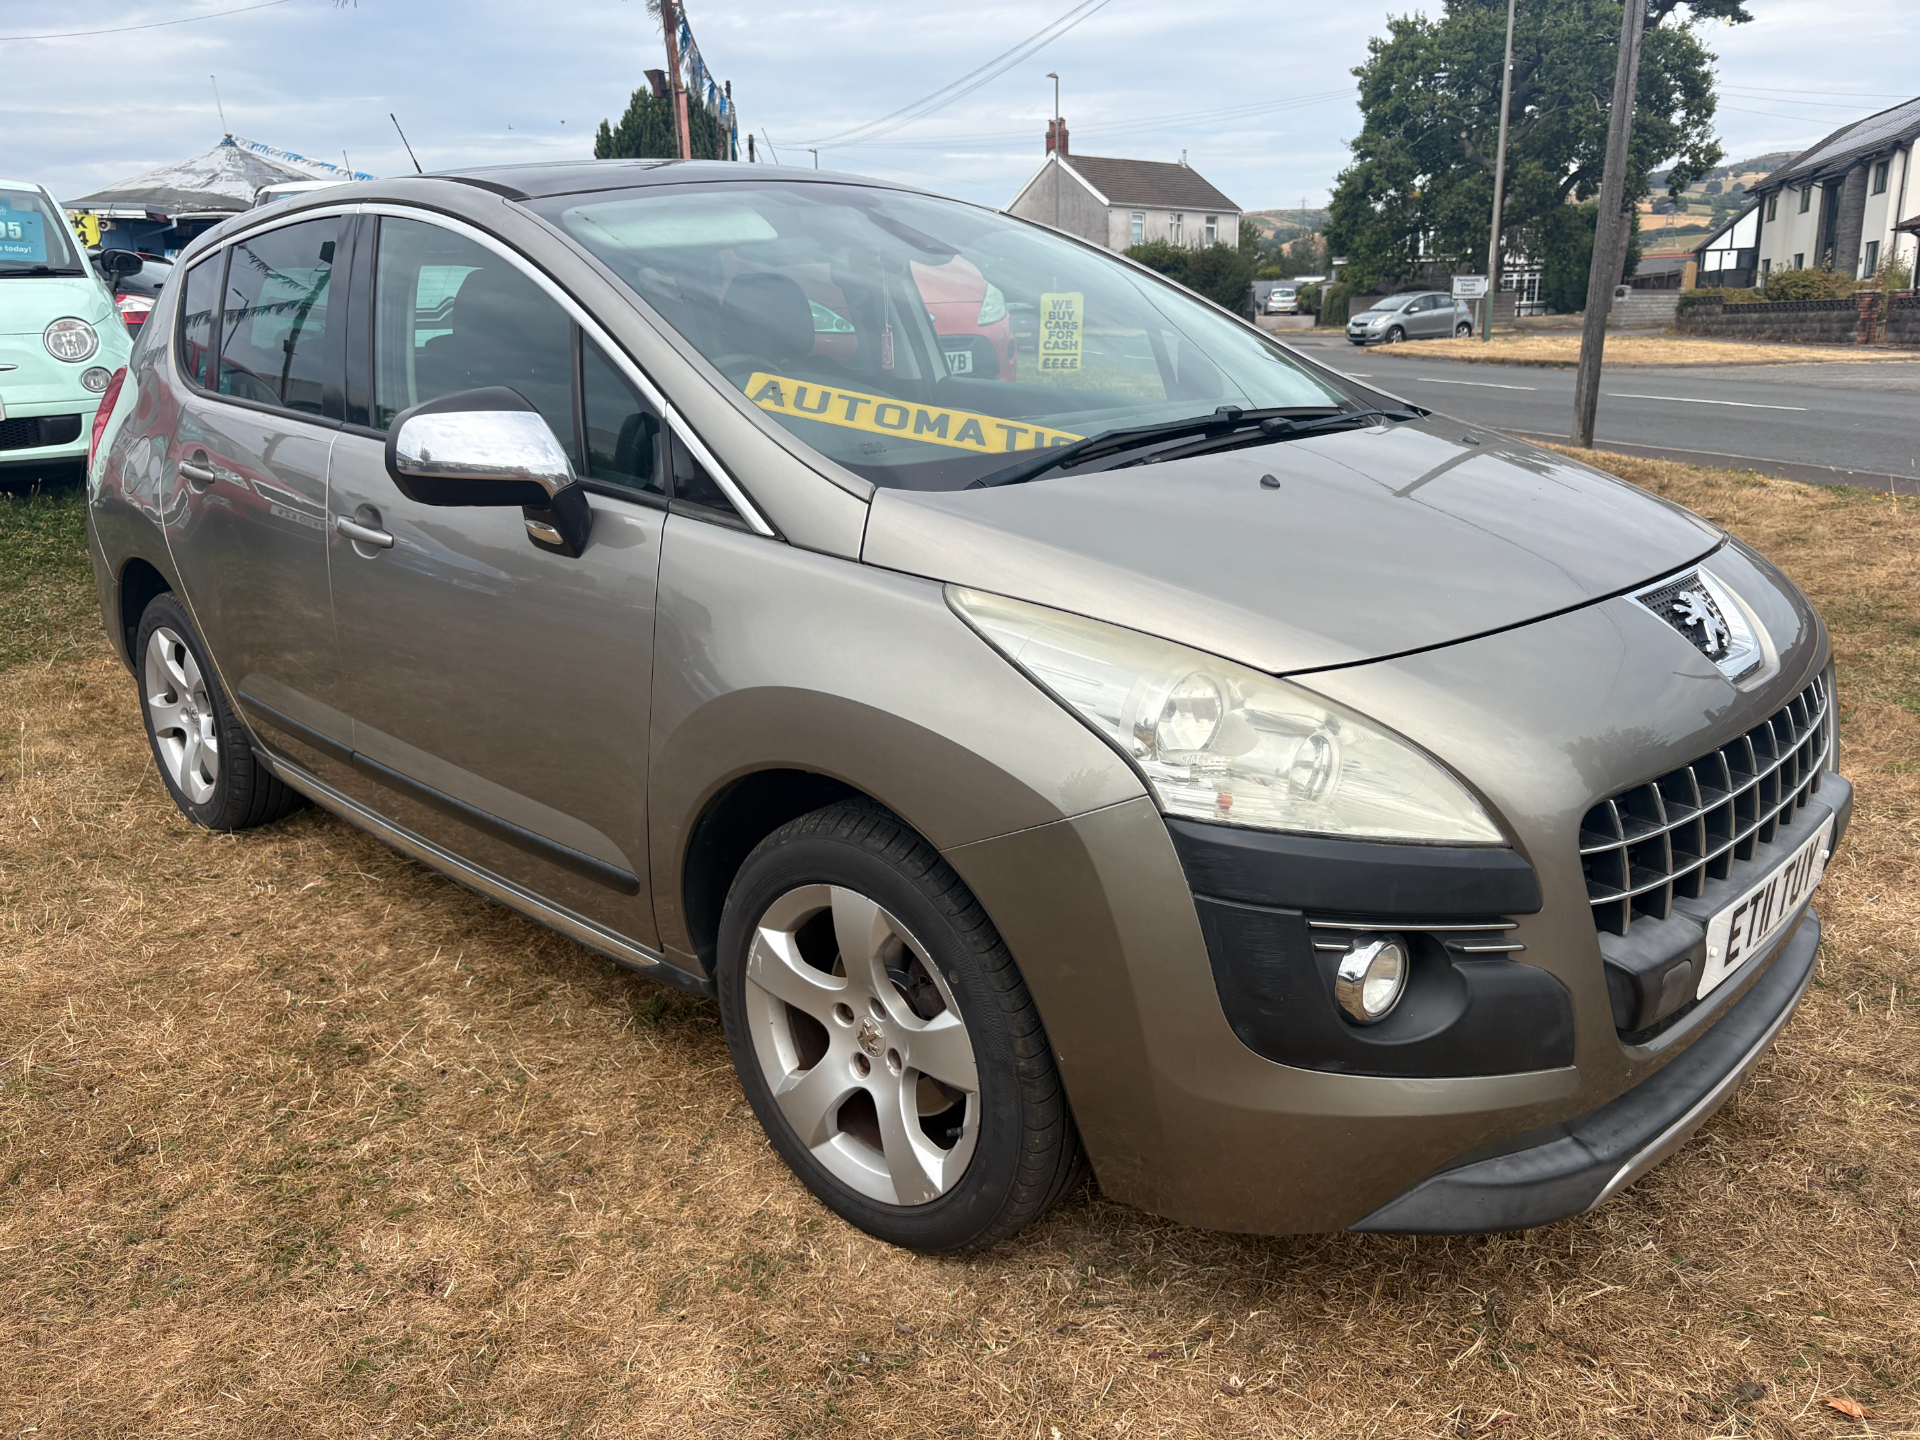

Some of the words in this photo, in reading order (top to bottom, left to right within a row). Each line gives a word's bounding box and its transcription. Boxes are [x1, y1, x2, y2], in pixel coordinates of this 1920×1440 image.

[4, 245, 32, 254] today!
[1051, 299, 1073, 310] WE
[1048, 310, 1075, 321] BUY
[1044, 320, 1079, 330] CARS
[1048, 330, 1074, 340] FOR
[1043, 340, 1078, 350] CASH
[1041, 357, 1078, 370] ££££
[1724, 877, 1779, 968] ET11
